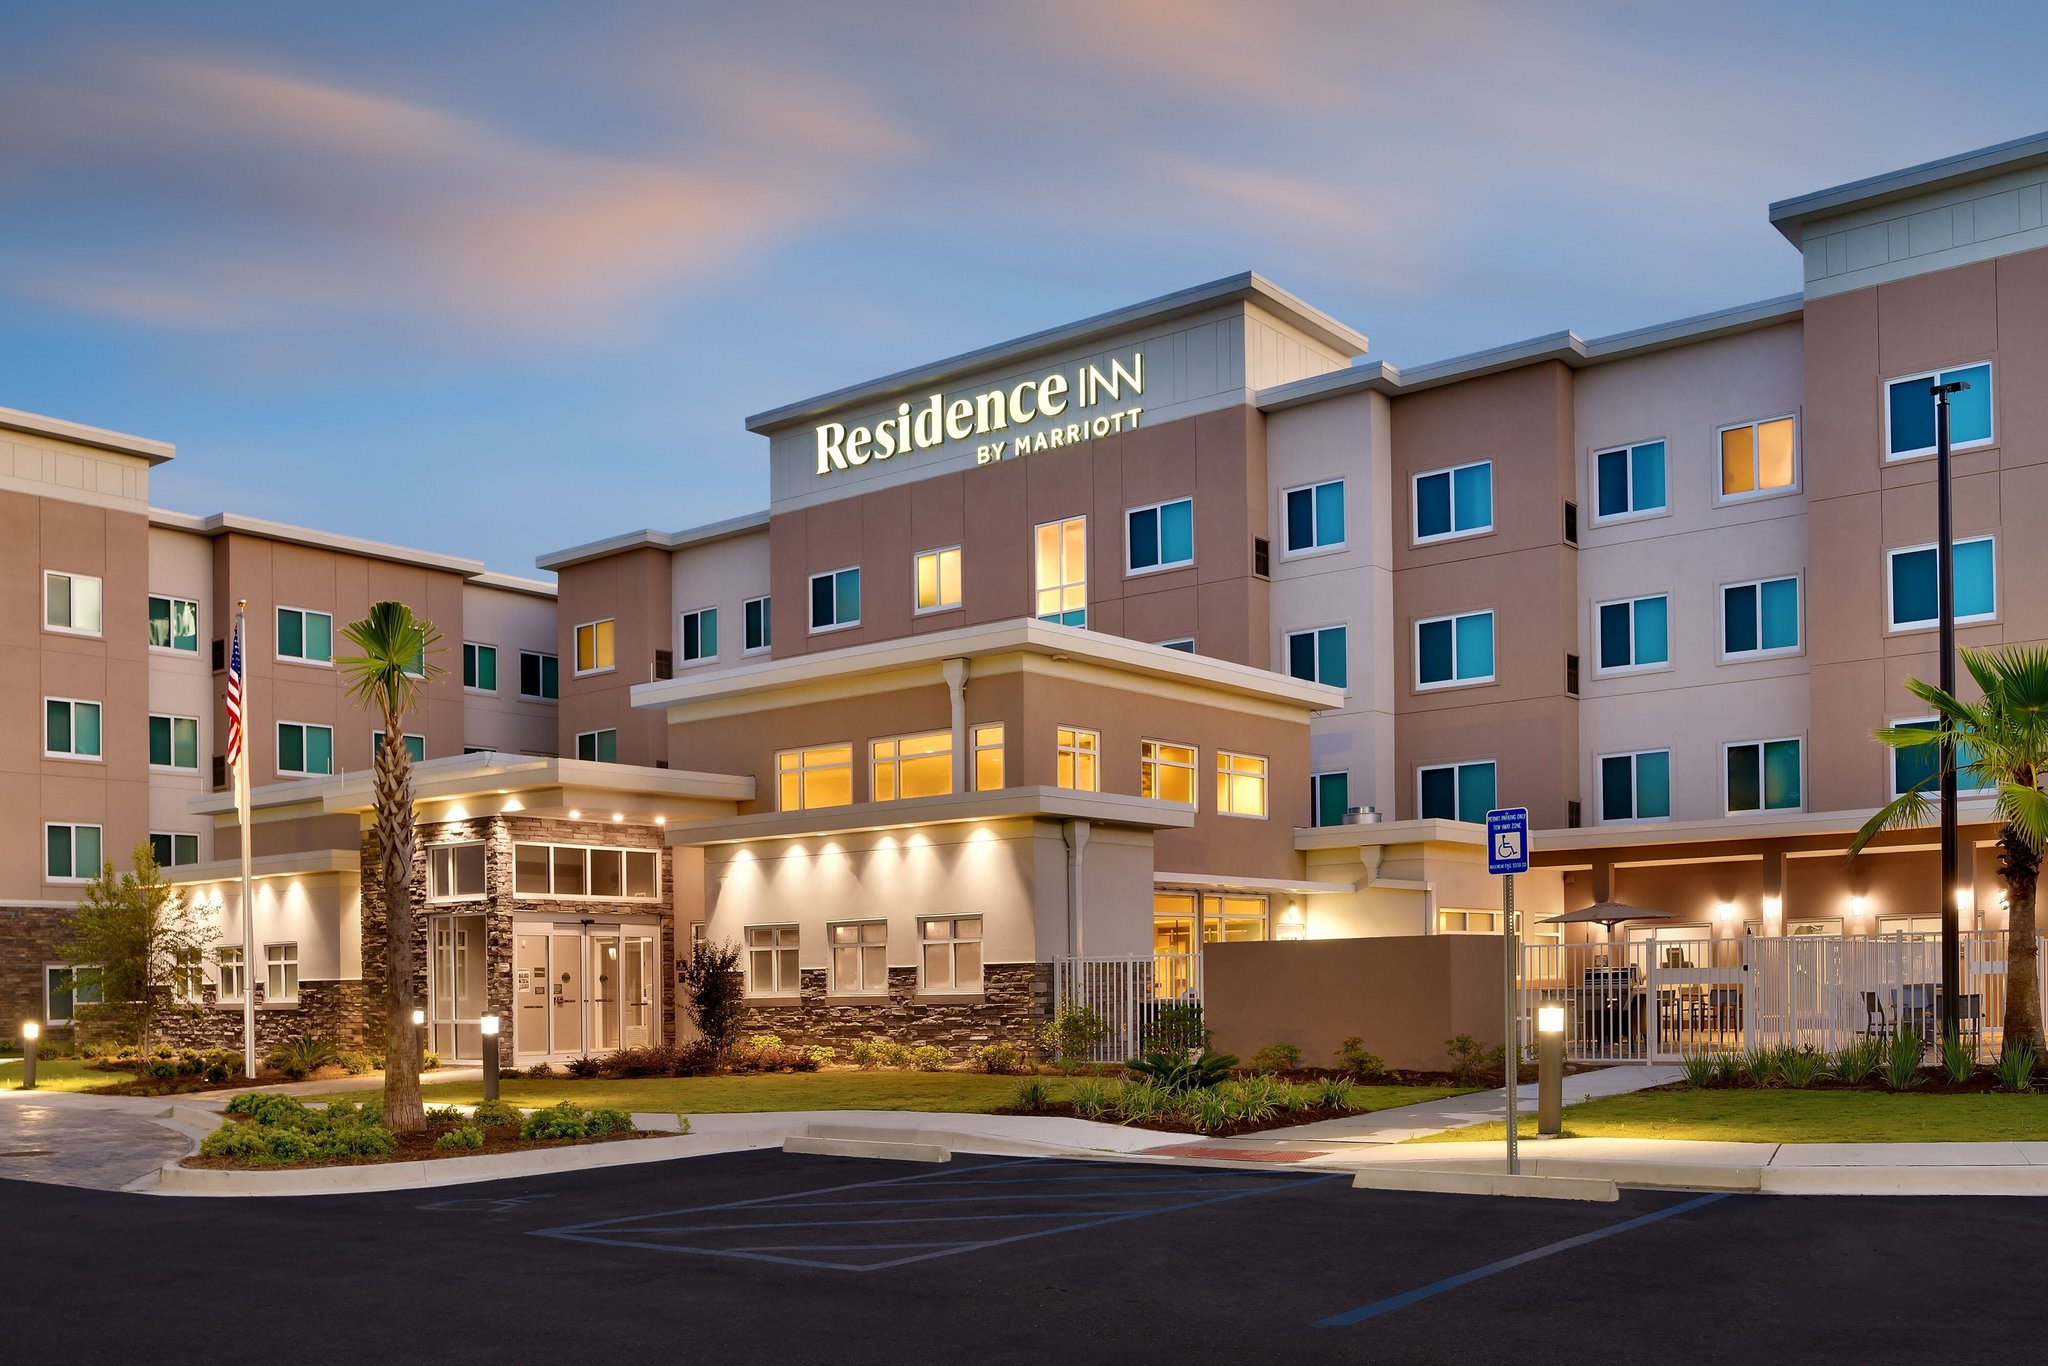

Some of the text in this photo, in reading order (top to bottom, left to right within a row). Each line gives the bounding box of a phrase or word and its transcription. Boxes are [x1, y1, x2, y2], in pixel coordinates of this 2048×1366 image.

[815, 353, 1143, 475] Residence INN
[977, 407, 1143, 465] BY MARRIOTT
